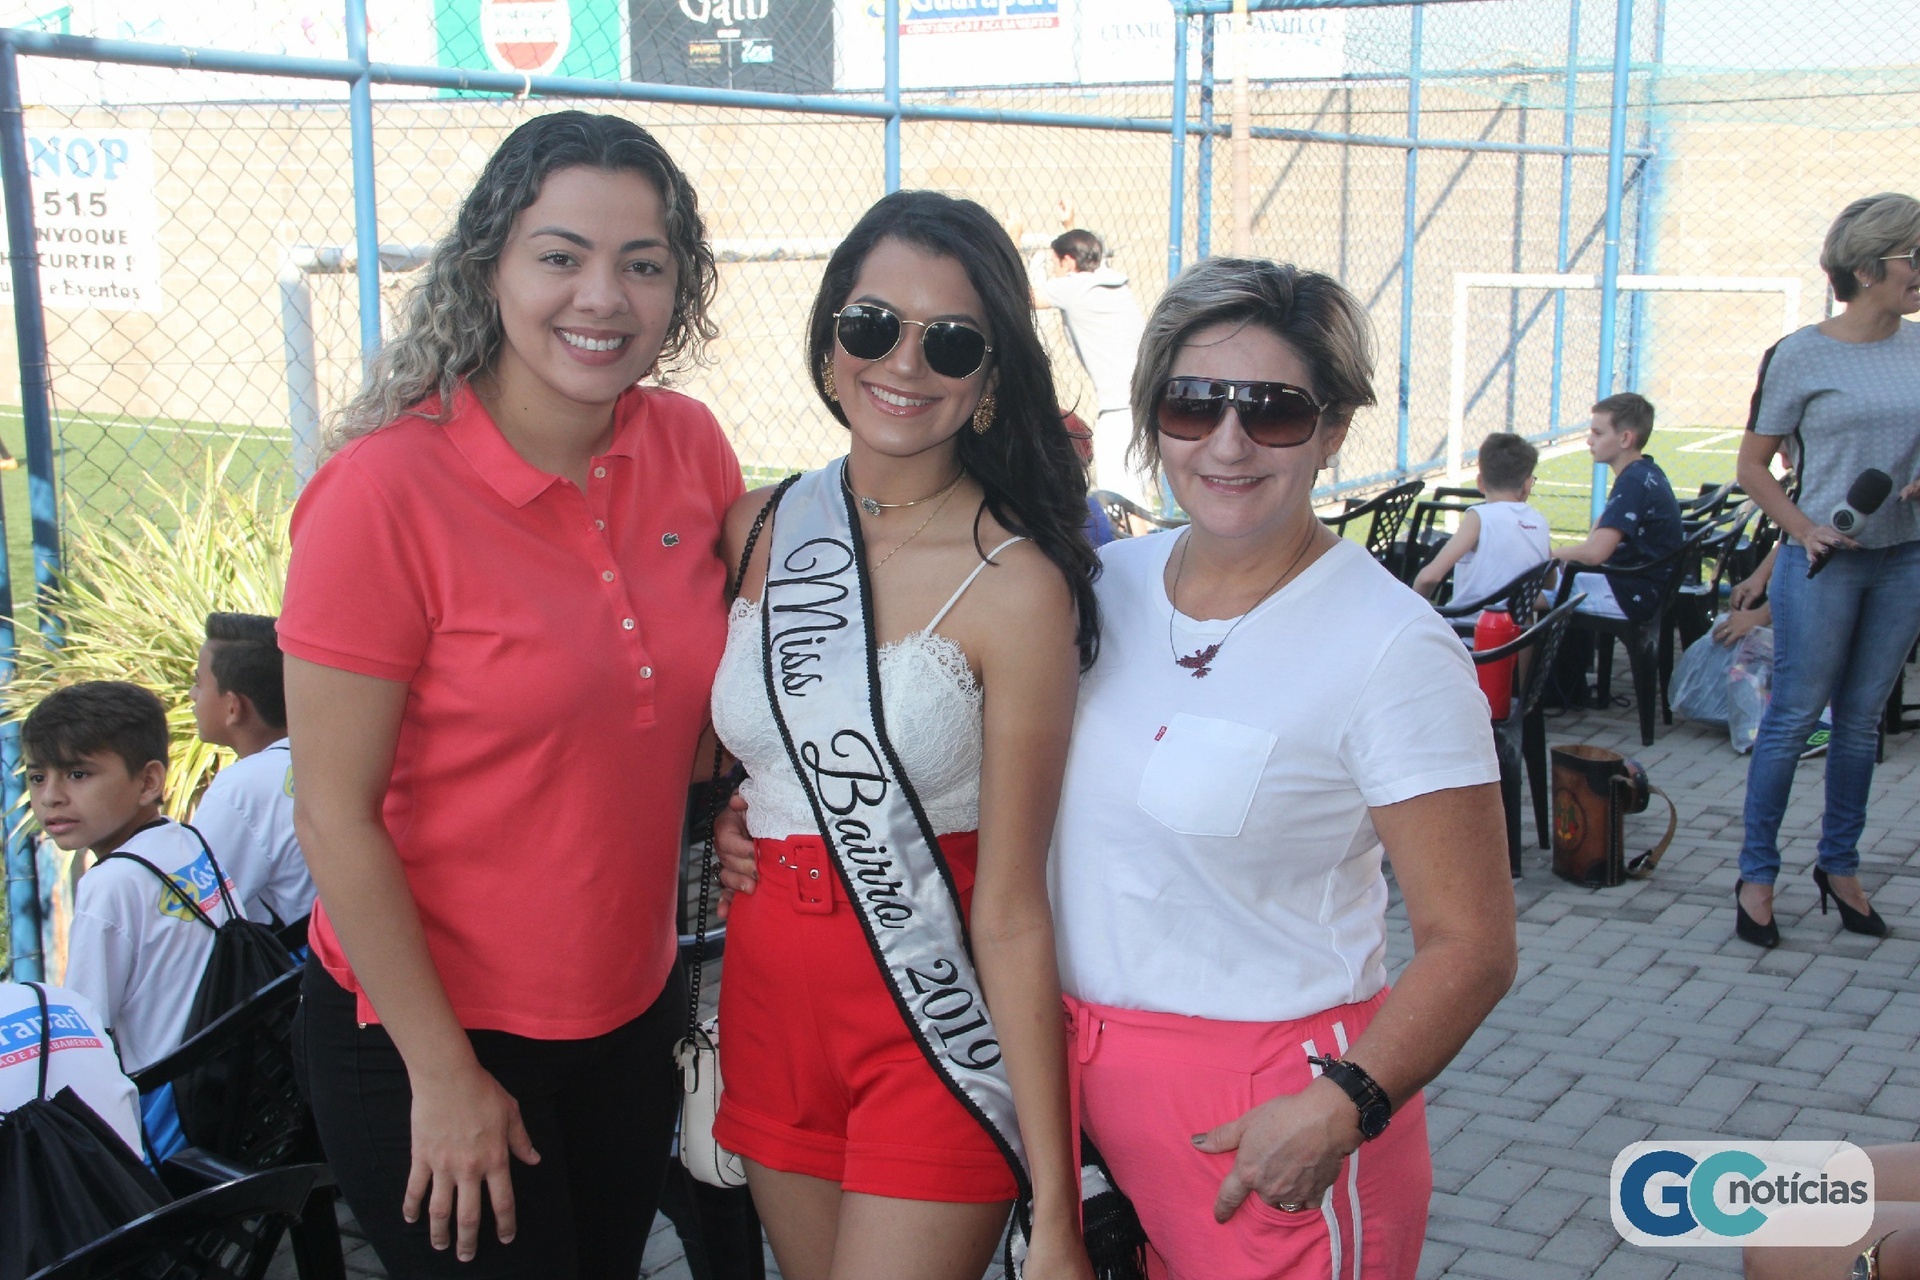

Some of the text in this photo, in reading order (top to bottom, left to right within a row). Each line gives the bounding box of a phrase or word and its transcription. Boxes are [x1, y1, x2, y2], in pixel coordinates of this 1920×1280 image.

[43, 191, 107, 217] 515
[768, 537, 1001, 1071] Miss Bairro 2019
